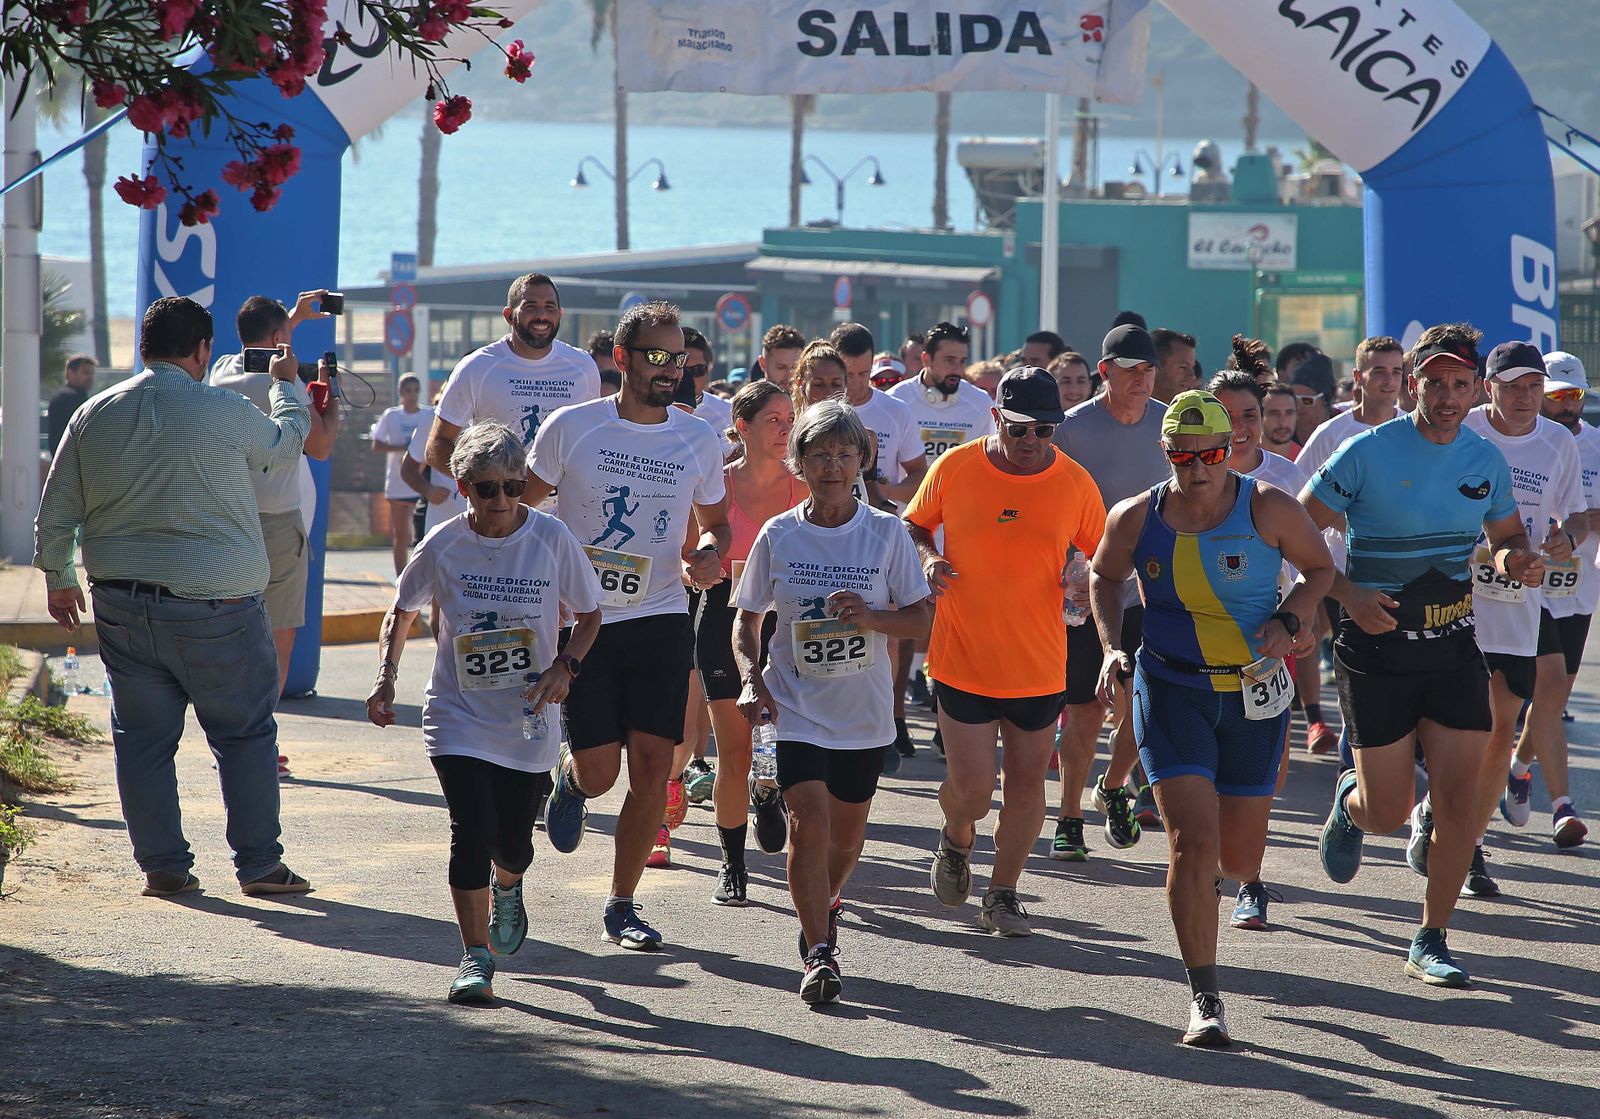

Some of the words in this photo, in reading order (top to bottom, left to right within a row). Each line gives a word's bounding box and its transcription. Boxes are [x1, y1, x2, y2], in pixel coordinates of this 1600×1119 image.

[797, 9, 1053, 57] SALIDA
[1375, 0, 1470, 79] TES
[678, 38, 733, 52] Malacitano
[511, 390, 533, 398] CIUDAD
[598, 449, 630, 460] XXIII
[632, 455, 686, 472] EDICIÓN
[604, 458, 641, 471] CARRERA
[643, 466, 675, 477] URBANA
[597, 464, 625, 475] CIUDAD
[626, 470, 637, 478] DE
[638, 472, 678, 486] ALGECIRAS
[1514, 474, 1541, 487] URBANA
[1513, 481, 1543, 495] LGECIRAS
[1002, 508, 1019, 518] NIKE
[788, 562, 819, 571] XXIII
[823, 565, 880, 575] EDICIÓN
[794, 569, 833, 579] CARRERA
[835, 573, 870, 582] URBANA
[460, 573, 493, 583] XXIII
[496, 577, 551, 588] EDICIÓN
[593, 567, 641, 595] 66
[788, 577, 816, 586] CIUDAD
[830, 581, 873, 591] ALGECIRAS
[467, 582, 506, 593] CARRERA
[507, 586, 541, 596] URBANA
[462, 589, 489, 600] CIUDAD
[490, 593, 501, 602] DE
[503, 595, 543, 605] ALGECIRAS
[803, 635, 866, 664] 322
[465, 647, 532, 676] 323
[1251, 666, 1289, 706] 310
